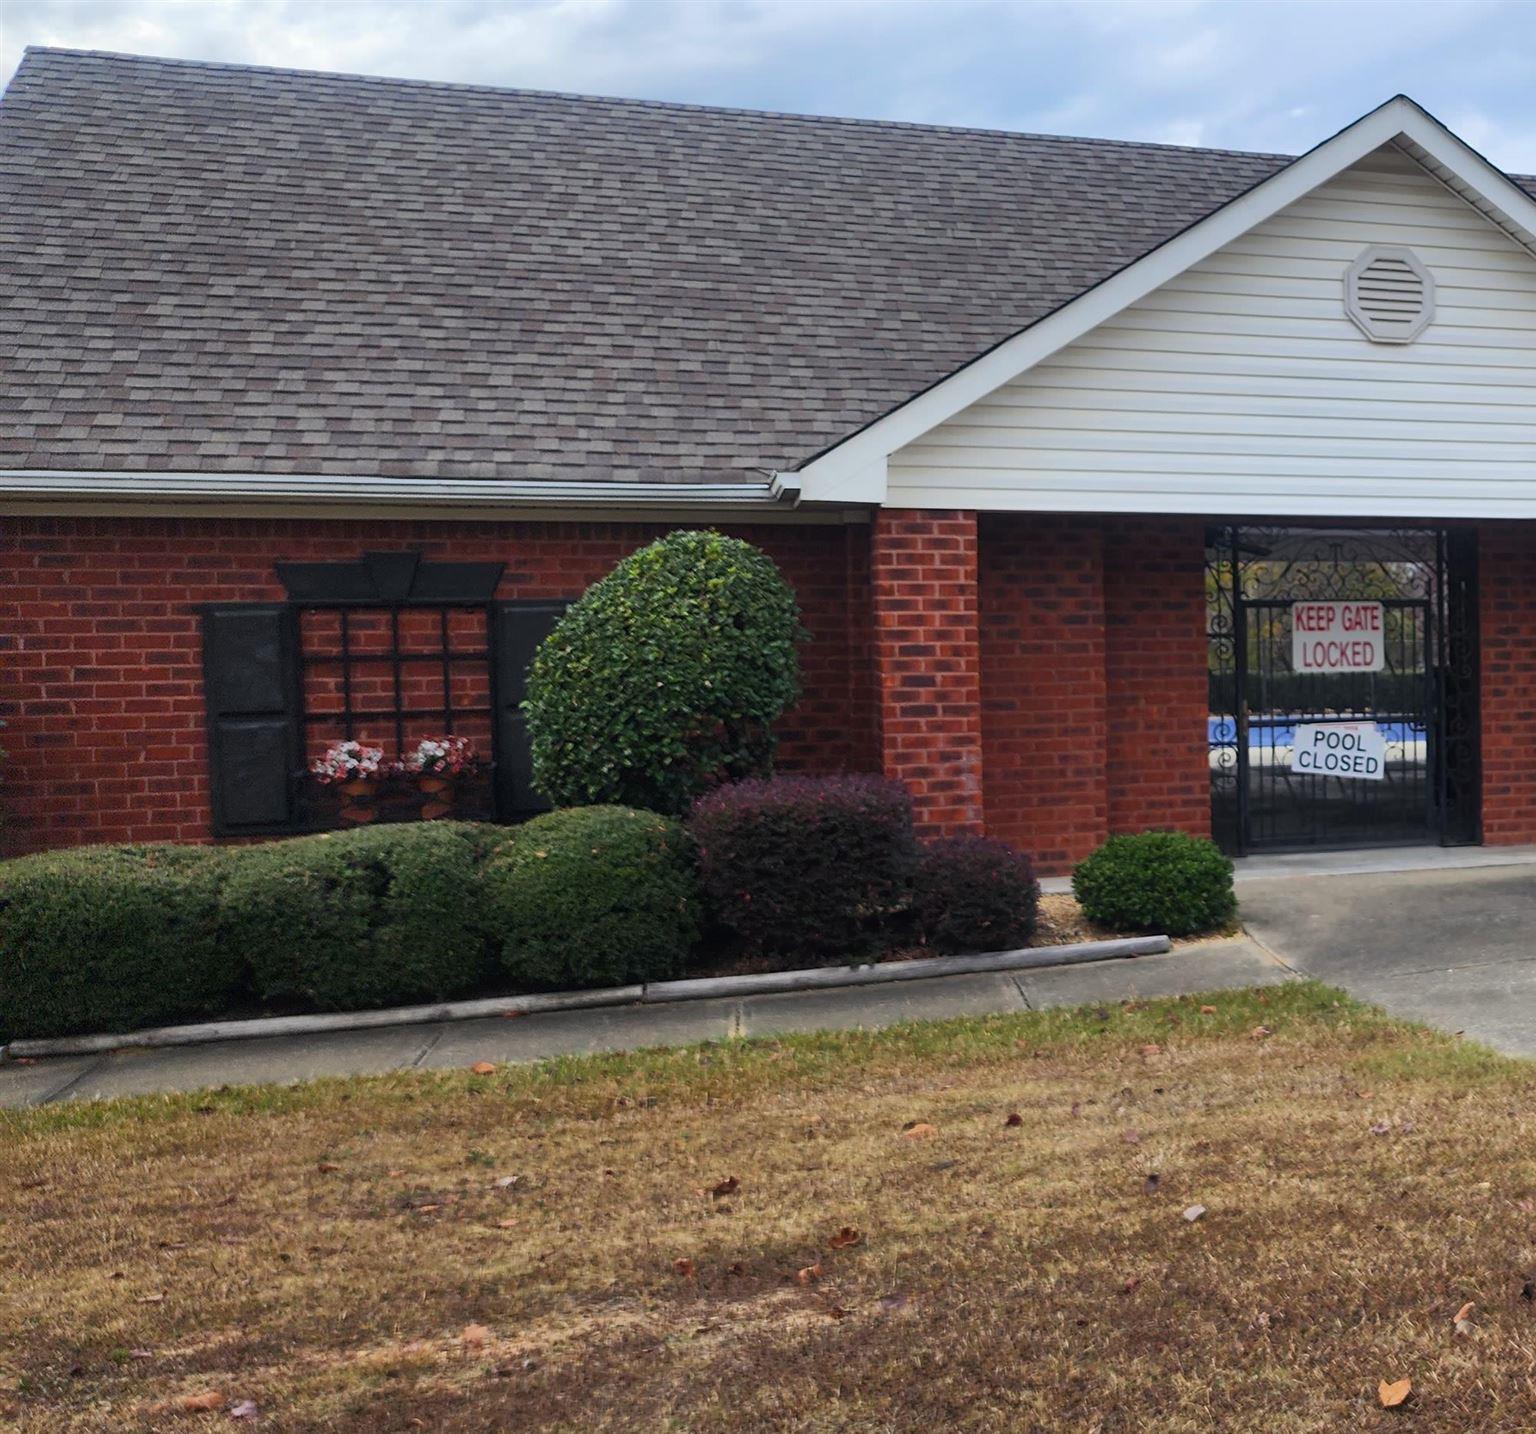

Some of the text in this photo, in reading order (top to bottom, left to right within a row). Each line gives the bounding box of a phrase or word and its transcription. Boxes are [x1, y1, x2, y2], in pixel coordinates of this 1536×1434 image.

[1295, 605, 1380, 631] KEEP GATE
[1302, 641, 1375, 667] LOCKED
[1313, 730, 1367, 752] POOL
[1298, 750, 1379, 774] CLOSED
